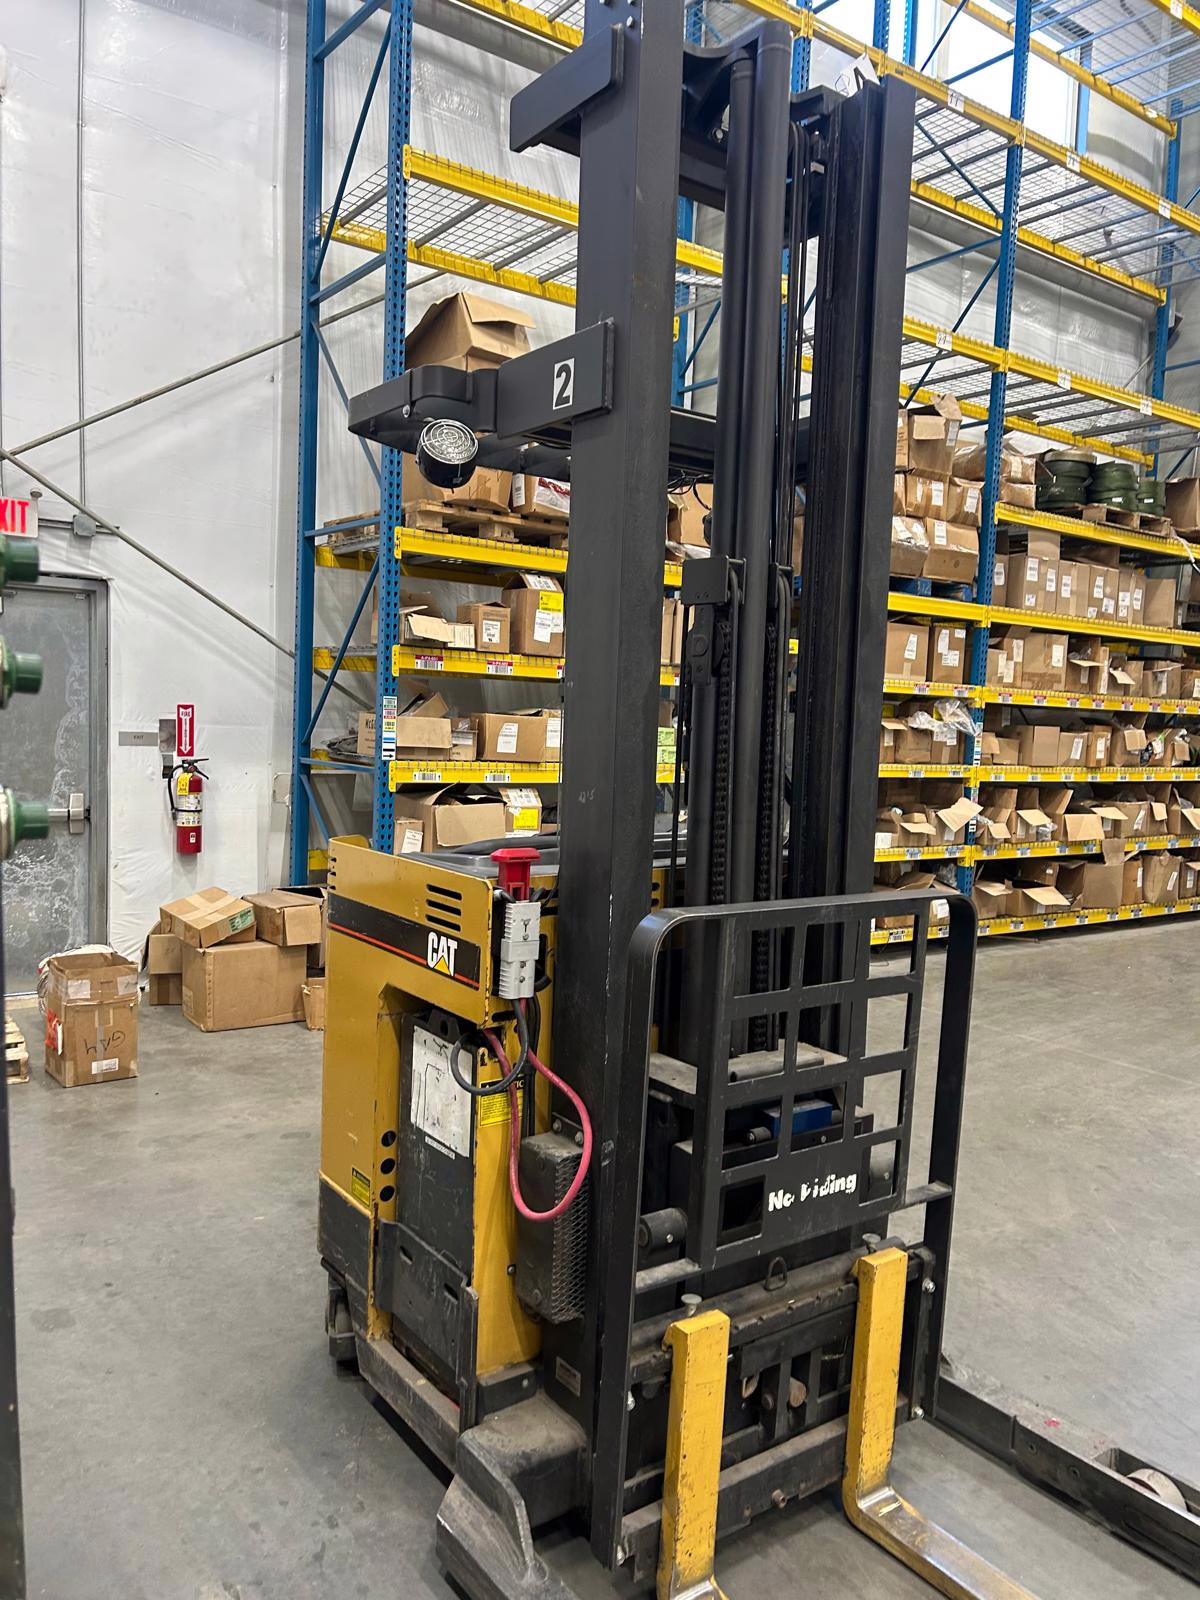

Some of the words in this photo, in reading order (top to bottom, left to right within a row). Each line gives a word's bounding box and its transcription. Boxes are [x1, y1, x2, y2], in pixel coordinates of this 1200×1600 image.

[555, 364, 571, 407] 2
[0, 499, 30, 533] XIT
[427, 931, 458, 977] CAT
[768, 1189, 795, 1212] No
